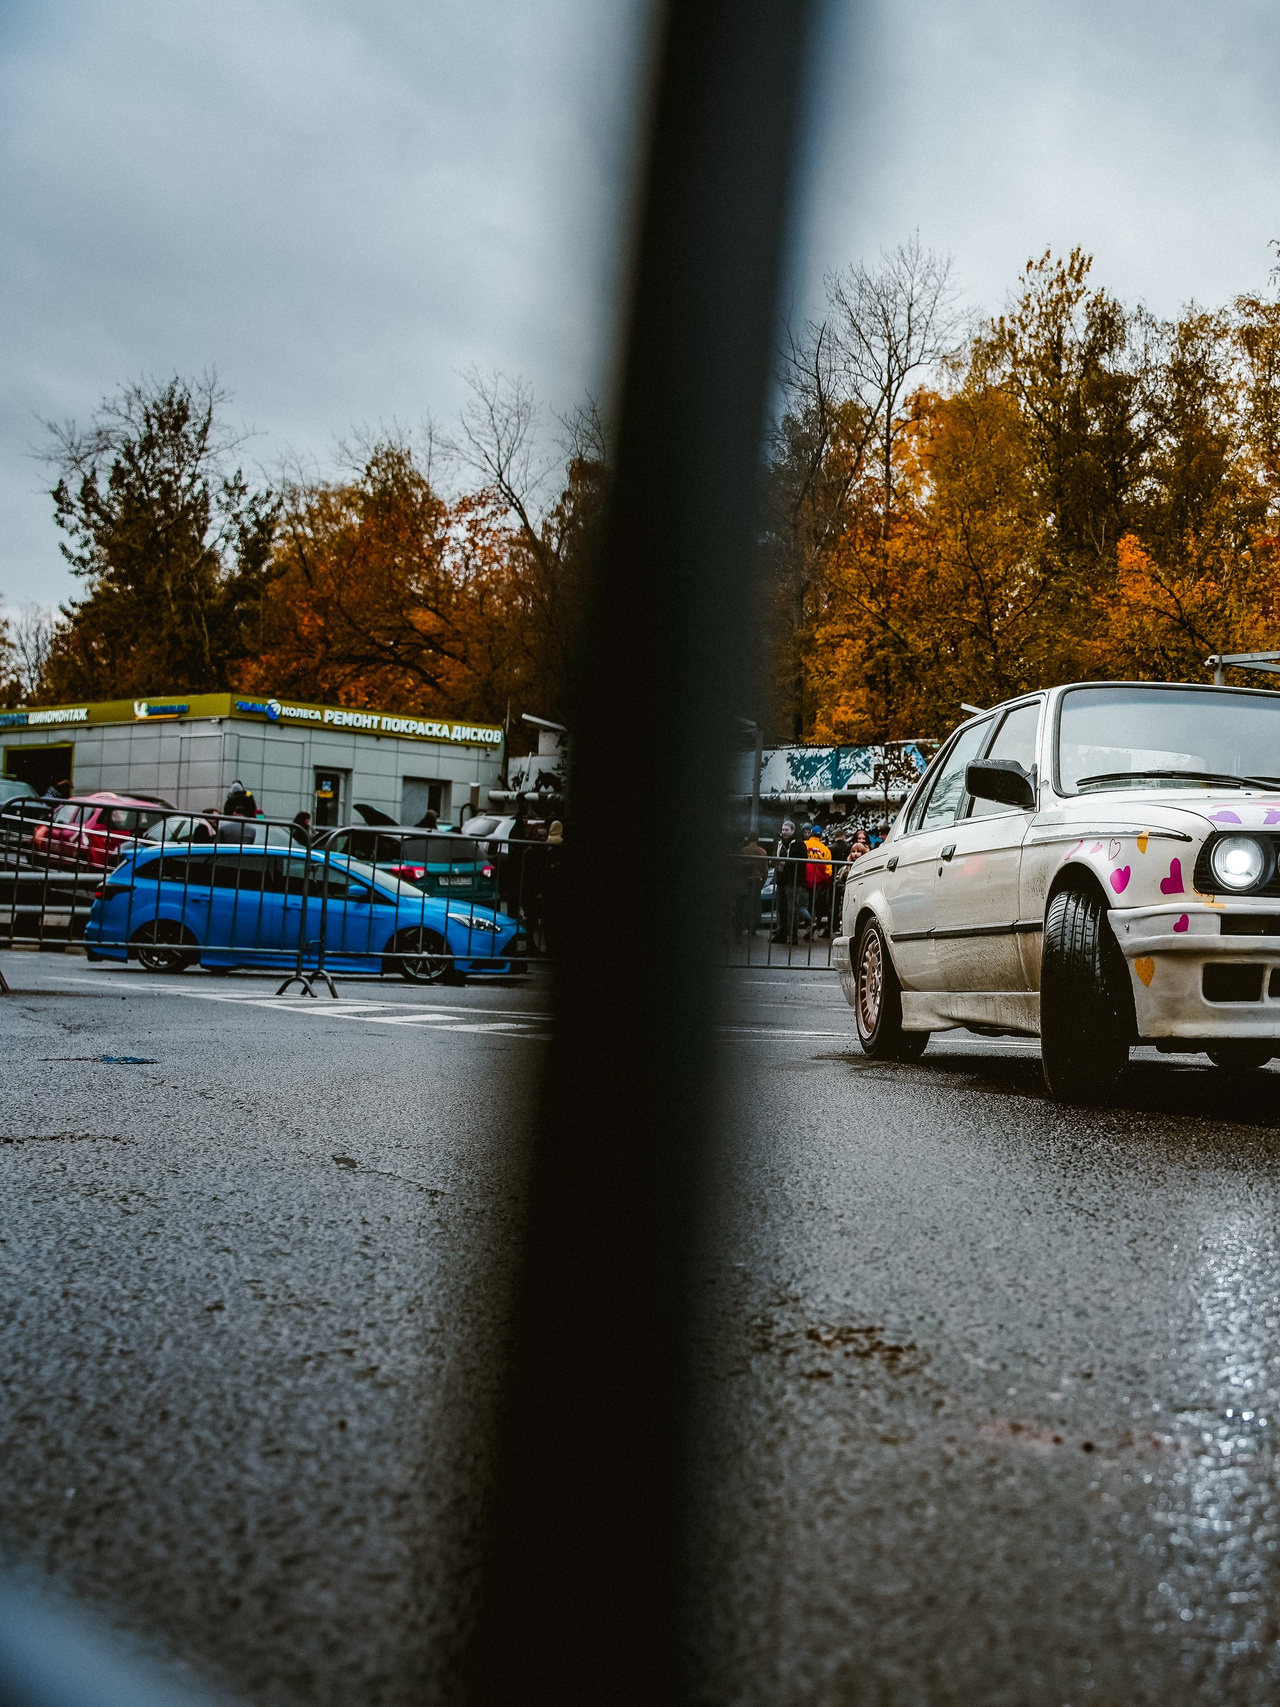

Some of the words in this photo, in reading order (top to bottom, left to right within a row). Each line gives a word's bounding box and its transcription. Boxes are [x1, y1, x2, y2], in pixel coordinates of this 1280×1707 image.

[28, 708, 88, 724] ШИНОМОНТАЖ
[282, 706, 322, 720] КОЛЕСА
[323, 709, 381, 729] РЕМОНТ
[381, 717, 450, 738] ПОКРАСКА
[450, 725, 502, 743] ДИСКОВ
